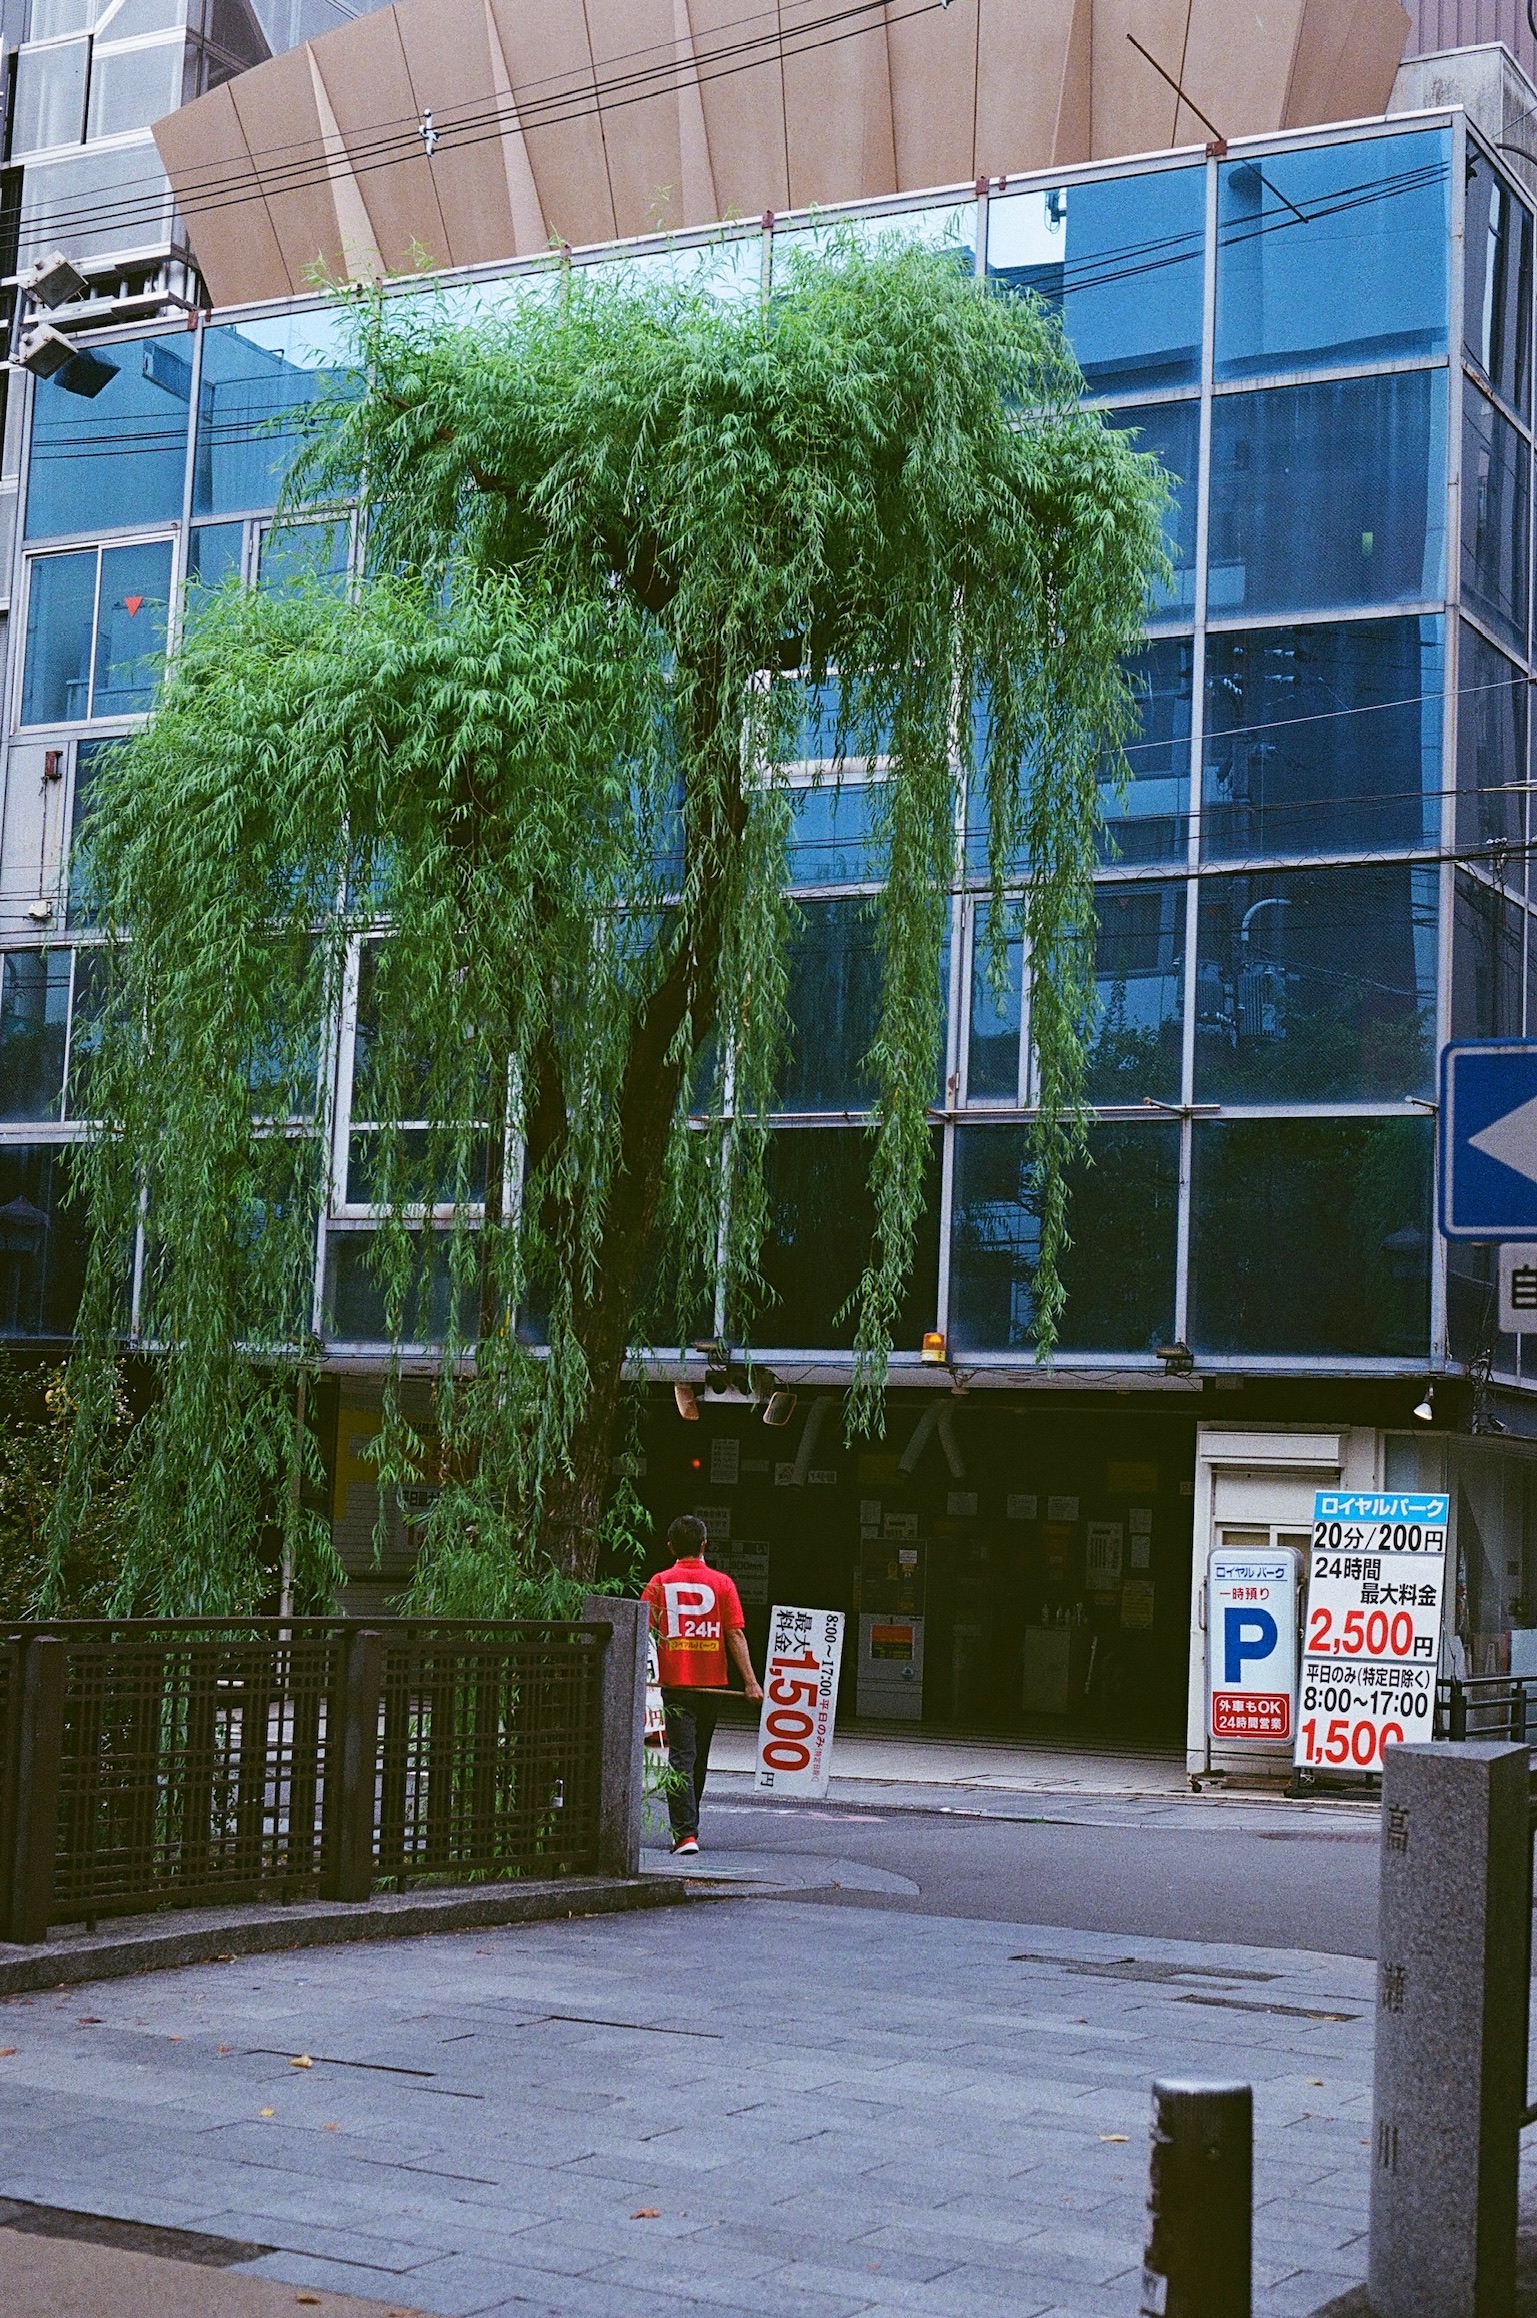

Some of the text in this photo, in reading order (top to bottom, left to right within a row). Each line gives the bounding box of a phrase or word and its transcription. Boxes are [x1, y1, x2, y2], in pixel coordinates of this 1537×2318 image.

[1322, 1497, 1444, 1518] ロイヤルパーク
[1315, 1557, 1381, 1580] 24時間
[1220, 1587, 1270, 1601] 一時預り
[1361, 1584, 1437, 1607] 最大料金
[662, 1582, 716, 1638] P
[684, 1620, 721, 1638] 24H
[1308, 1608, 1433, 1658] 2,500円
[1224, 1607, 1279, 1683] P
[1219, 1700, 1282, 1714] 外車もOK
[816, 1698, 830, 1748] 平日のみ
[1219, 1715, 1282, 1730] 24時間営業
